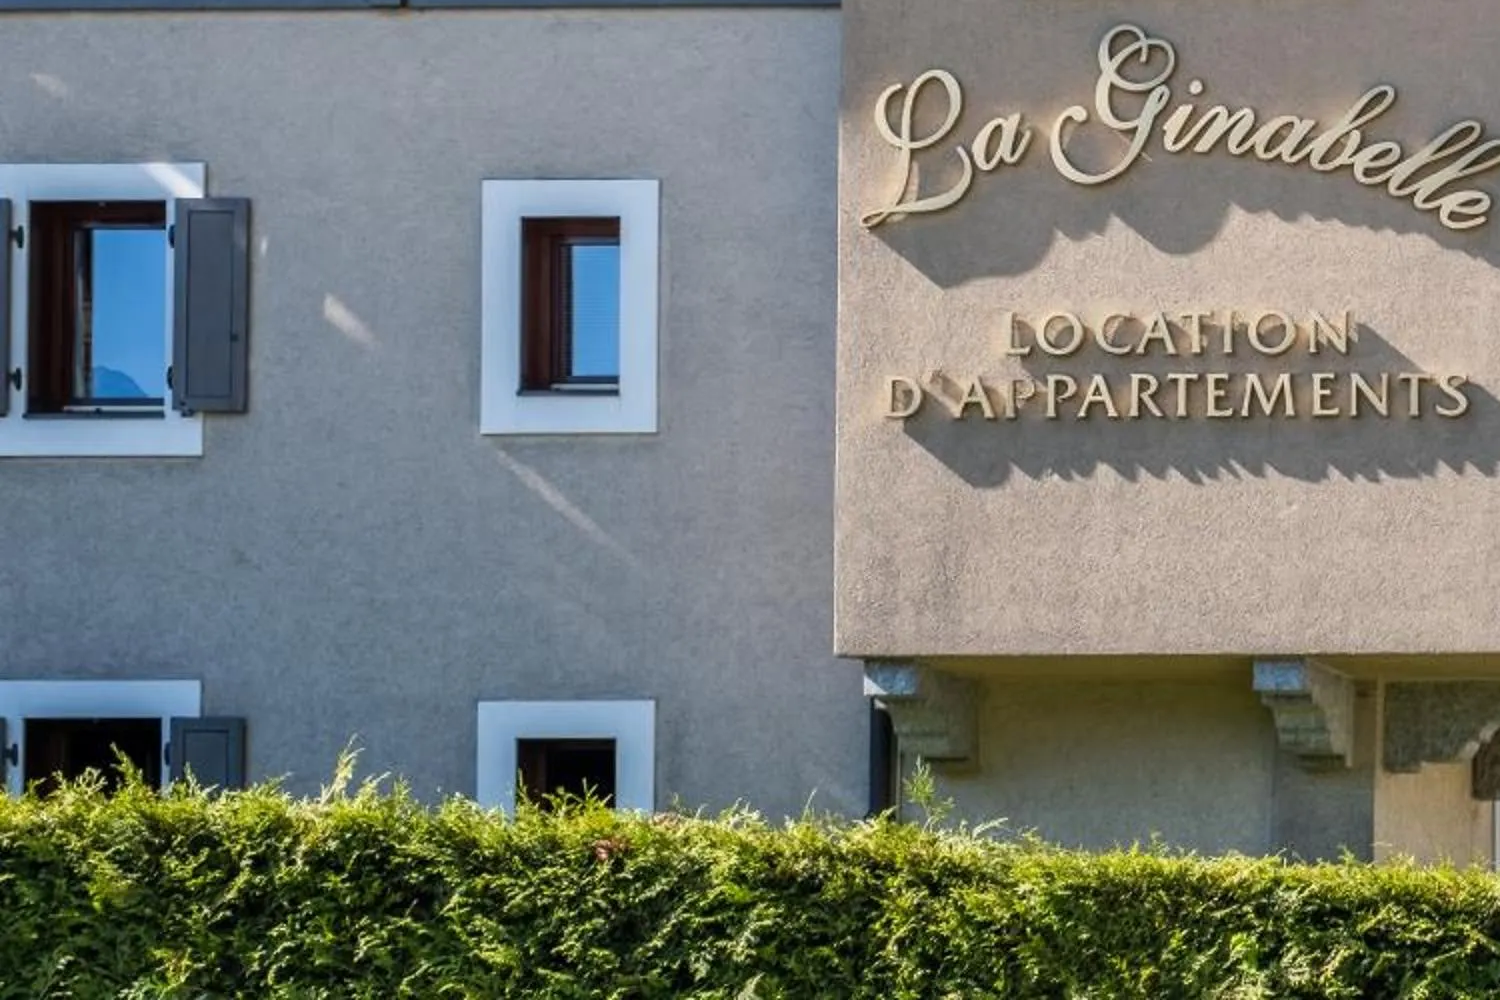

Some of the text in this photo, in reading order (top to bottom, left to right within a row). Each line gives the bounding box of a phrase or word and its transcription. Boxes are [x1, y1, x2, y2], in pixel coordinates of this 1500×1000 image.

[859, 69, 1034, 231] La
[1002, 309, 1356, 357] LOCATION
[883, 370, 1471, 419] D'APPARTEMENTS
